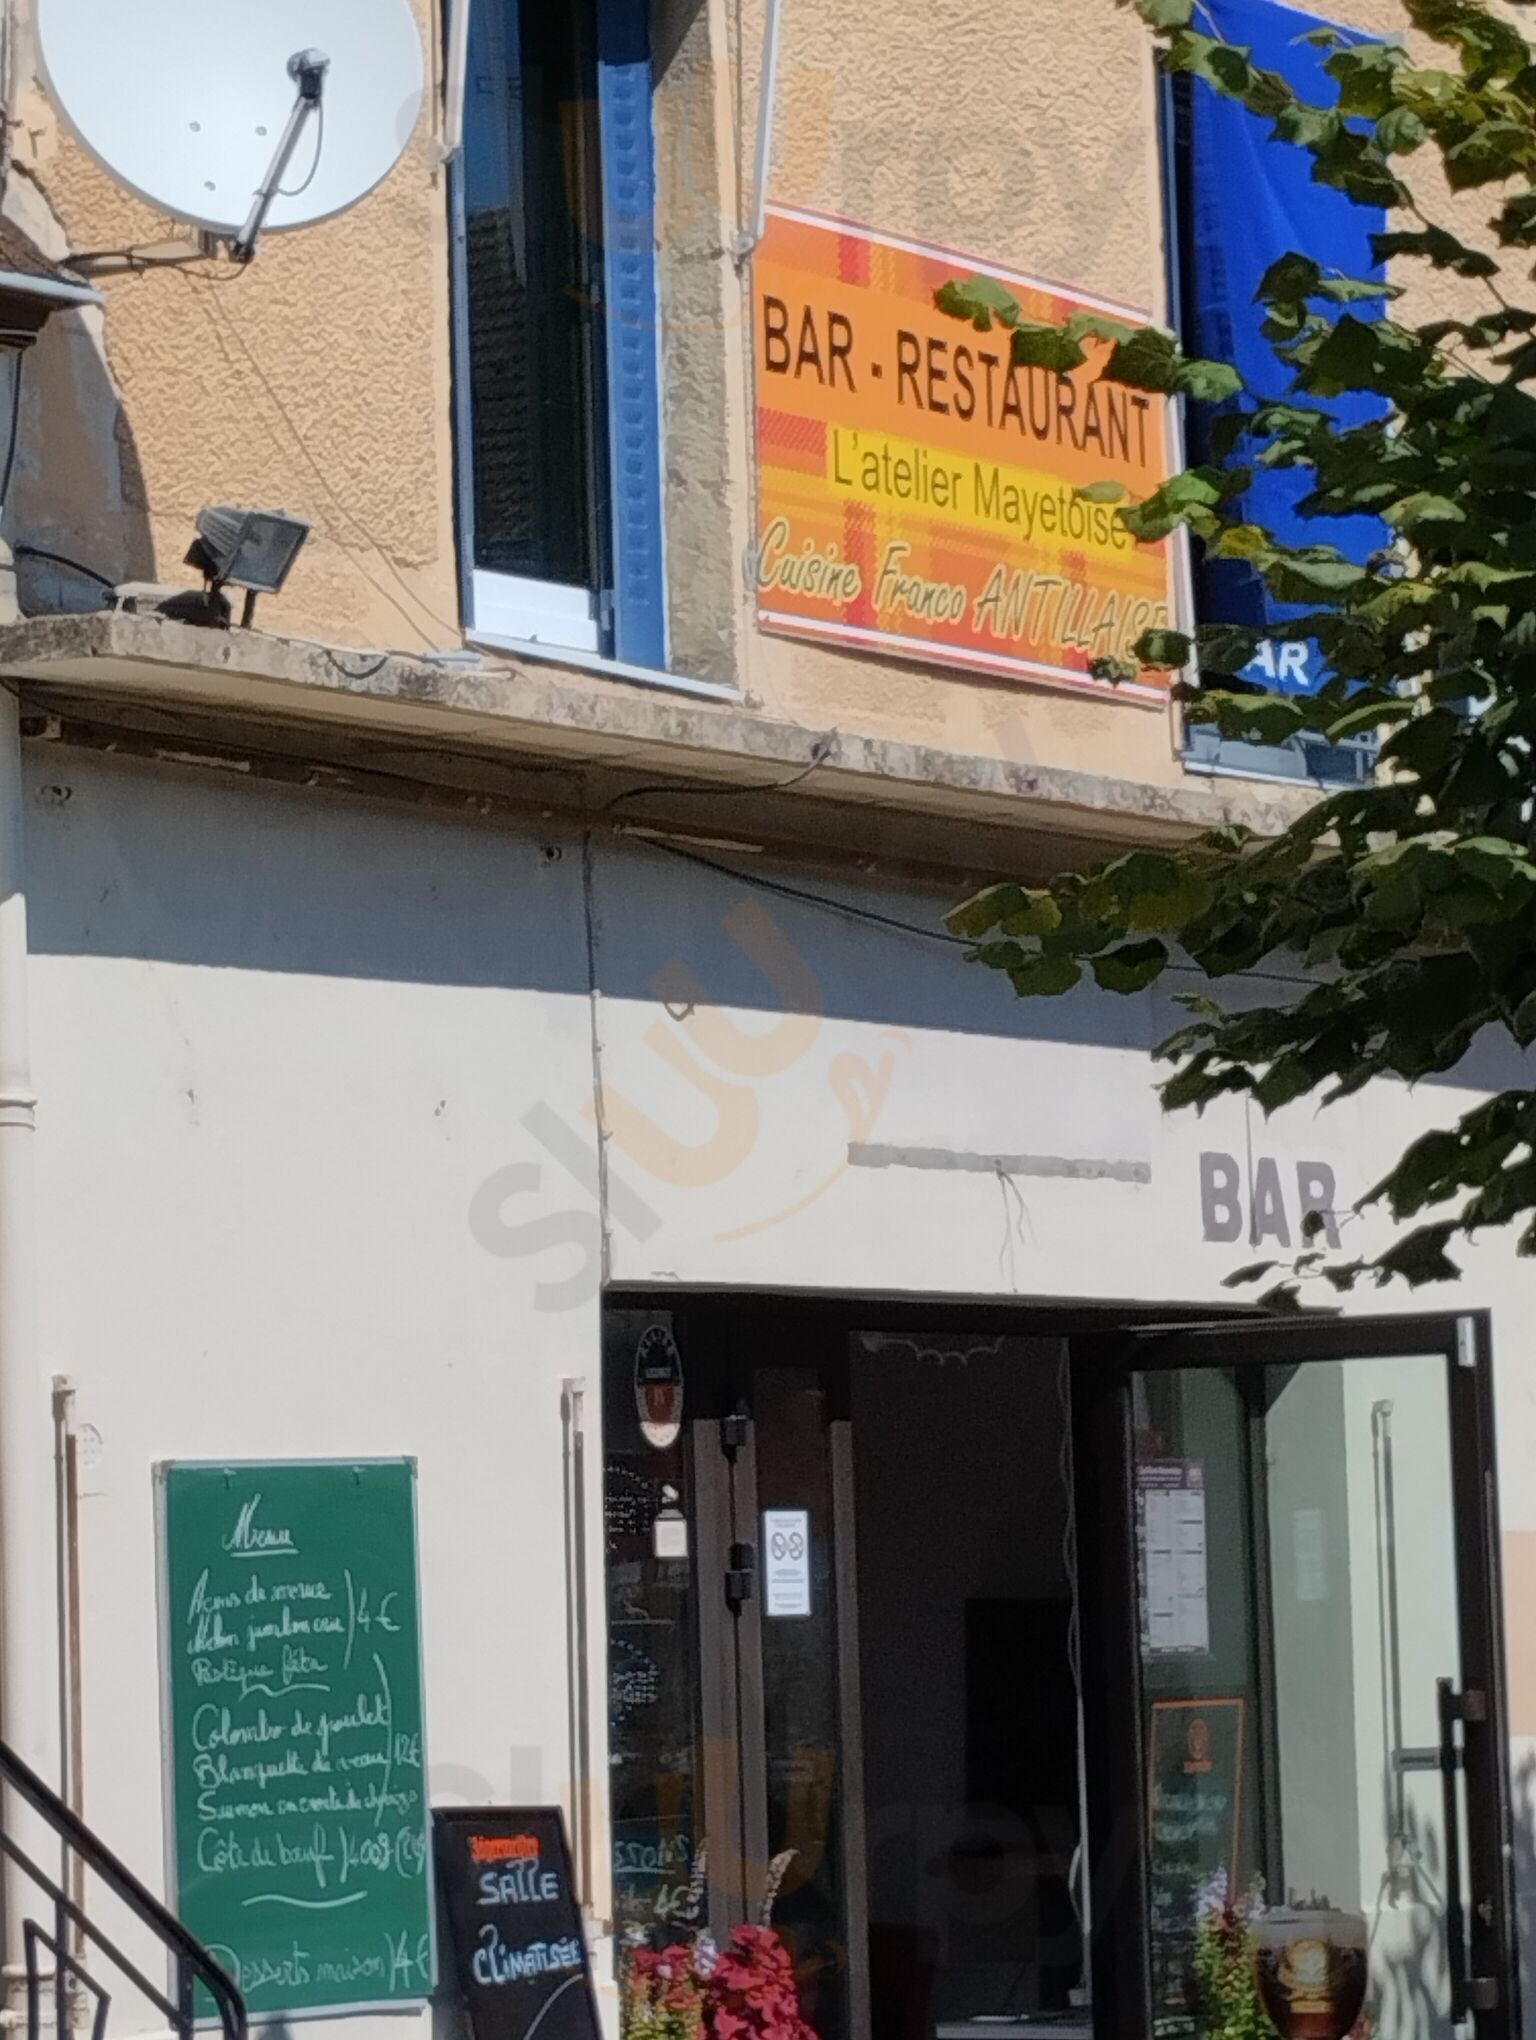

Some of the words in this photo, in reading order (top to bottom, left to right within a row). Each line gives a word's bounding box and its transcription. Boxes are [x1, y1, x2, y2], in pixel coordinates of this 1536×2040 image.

[764, 296, 856, 392] BAR
[897, 330, 1150, 468] RESTAURANT
[974, 462, 1128, 550] Mayetoise
[759, 518, 861, 606] Cuisine
[872, 542, 967, 625] Franco
[1200, 1151, 1342, 1249] BAR
[222, 1493, 294, 1550] Menu
[192, 1703, 284, 1751] Colombo
[291, 1709, 312, 1736] de
[316, 1693, 391, 1757] poulet
[250, 1837, 276, 1867] de
[477, 1857, 560, 1905] SALLE
